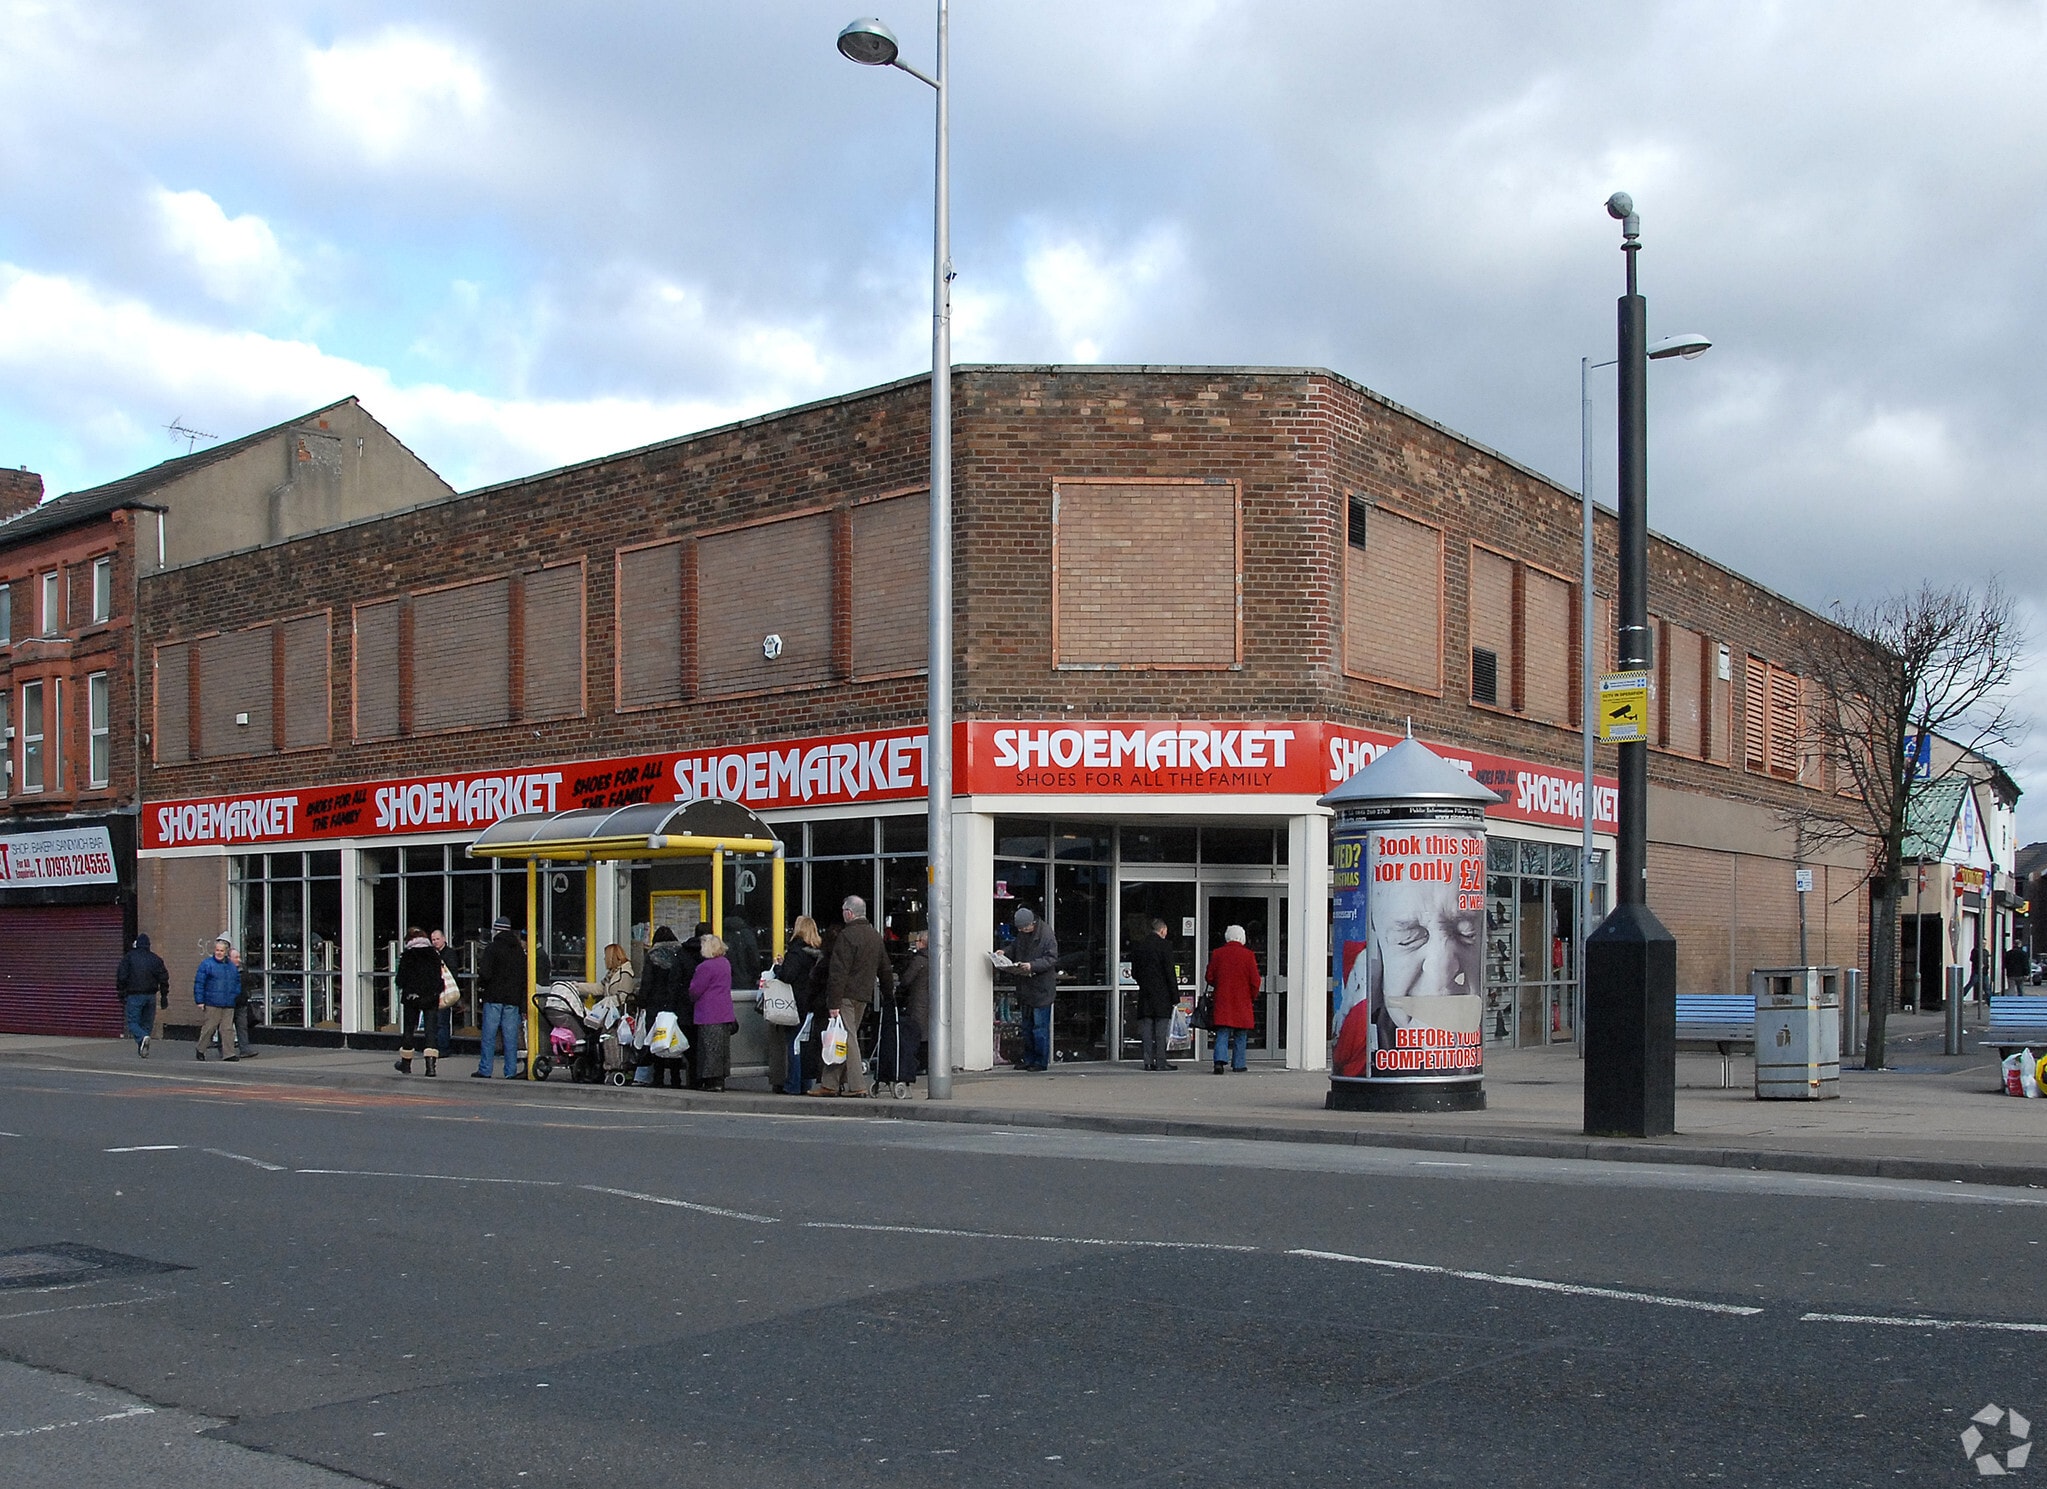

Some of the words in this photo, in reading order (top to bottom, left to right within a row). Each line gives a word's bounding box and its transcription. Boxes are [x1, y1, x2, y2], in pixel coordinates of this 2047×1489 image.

[993, 729, 1295, 772] SHOEMARKET
[572, 772, 612, 797] SHOES
[614, 766, 639, 787] FOR
[641, 760, 663, 781] ALL
[674, 735, 928, 801] SHOEMARKET
[1016, 772, 1076, 787] SHOES
[1085, 772, 1122, 787] FOR
[1130, 772, 1163, 787] ALL
[1168, 772, 1203, 787] THE
[1209, 772, 1273, 787] FAMILY
[305, 797, 334, 817] SHOES
[333, 793, 351, 810] FOR
[352, 788, 367, 805] ALL
[374, 772, 563, 831] SHOEMARKET
[608, 784, 654, 807] FAMILY
[1517, 771, 1618, 822] SHOEMAKET
[158, 796, 298, 845] SHOEMARKET
[312, 816, 329, 832] THE
[330, 808, 362, 829] FAMILY
[89, 837, 105, 850] BAR
[1379, 835, 1421, 855] Book
[1425, 835, 1458, 855] this
[1461, 838, 1484, 857] spac
[46, 855, 72, 877] 07973
[72, 852, 111, 876] 224555
[1409, 859, 1453, 883] only
[1459, 895, 1467, 910] a
[1397, 1029, 1455, 1047] BEFORE
[1376, 1047, 1477, 1070] COMPETITORS
